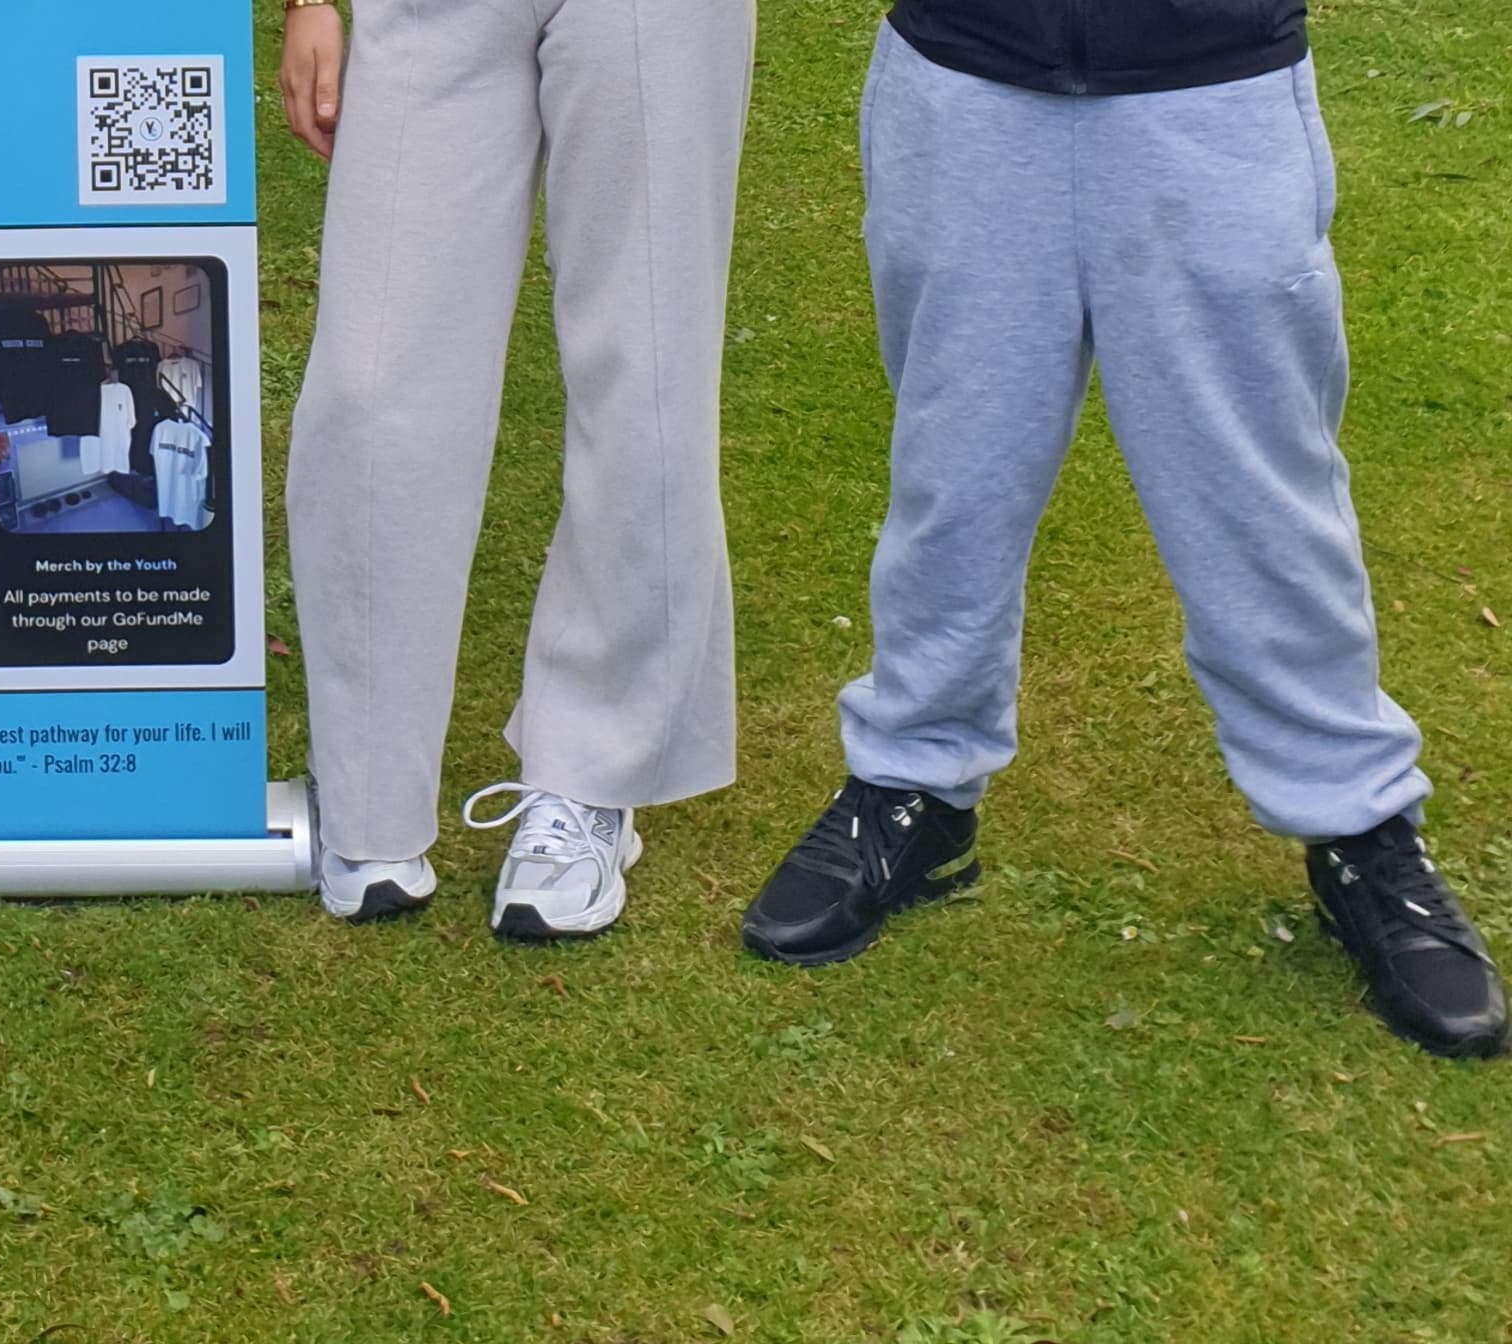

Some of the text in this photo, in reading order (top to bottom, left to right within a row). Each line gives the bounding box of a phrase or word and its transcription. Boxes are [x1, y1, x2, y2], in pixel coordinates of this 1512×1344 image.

[36, 559, 177, 574] Merch by the Youth
[4, 588, 210, 607] All payments to be made
[12, 612, 203, 631] through our GoFundMe
[87, 639, 128, 654] page
[30, 724, 99, 747] pathway
[105, 724, 128, 743] for
[133, 726, 169, 746] your
[175, 722, 206, 743] life.
[211, 723, 216, 742] I
[221, 722, 251, 742] will
[44, 754, 94, 774] Psalm
[99, 753, 137, 773] 32:8
